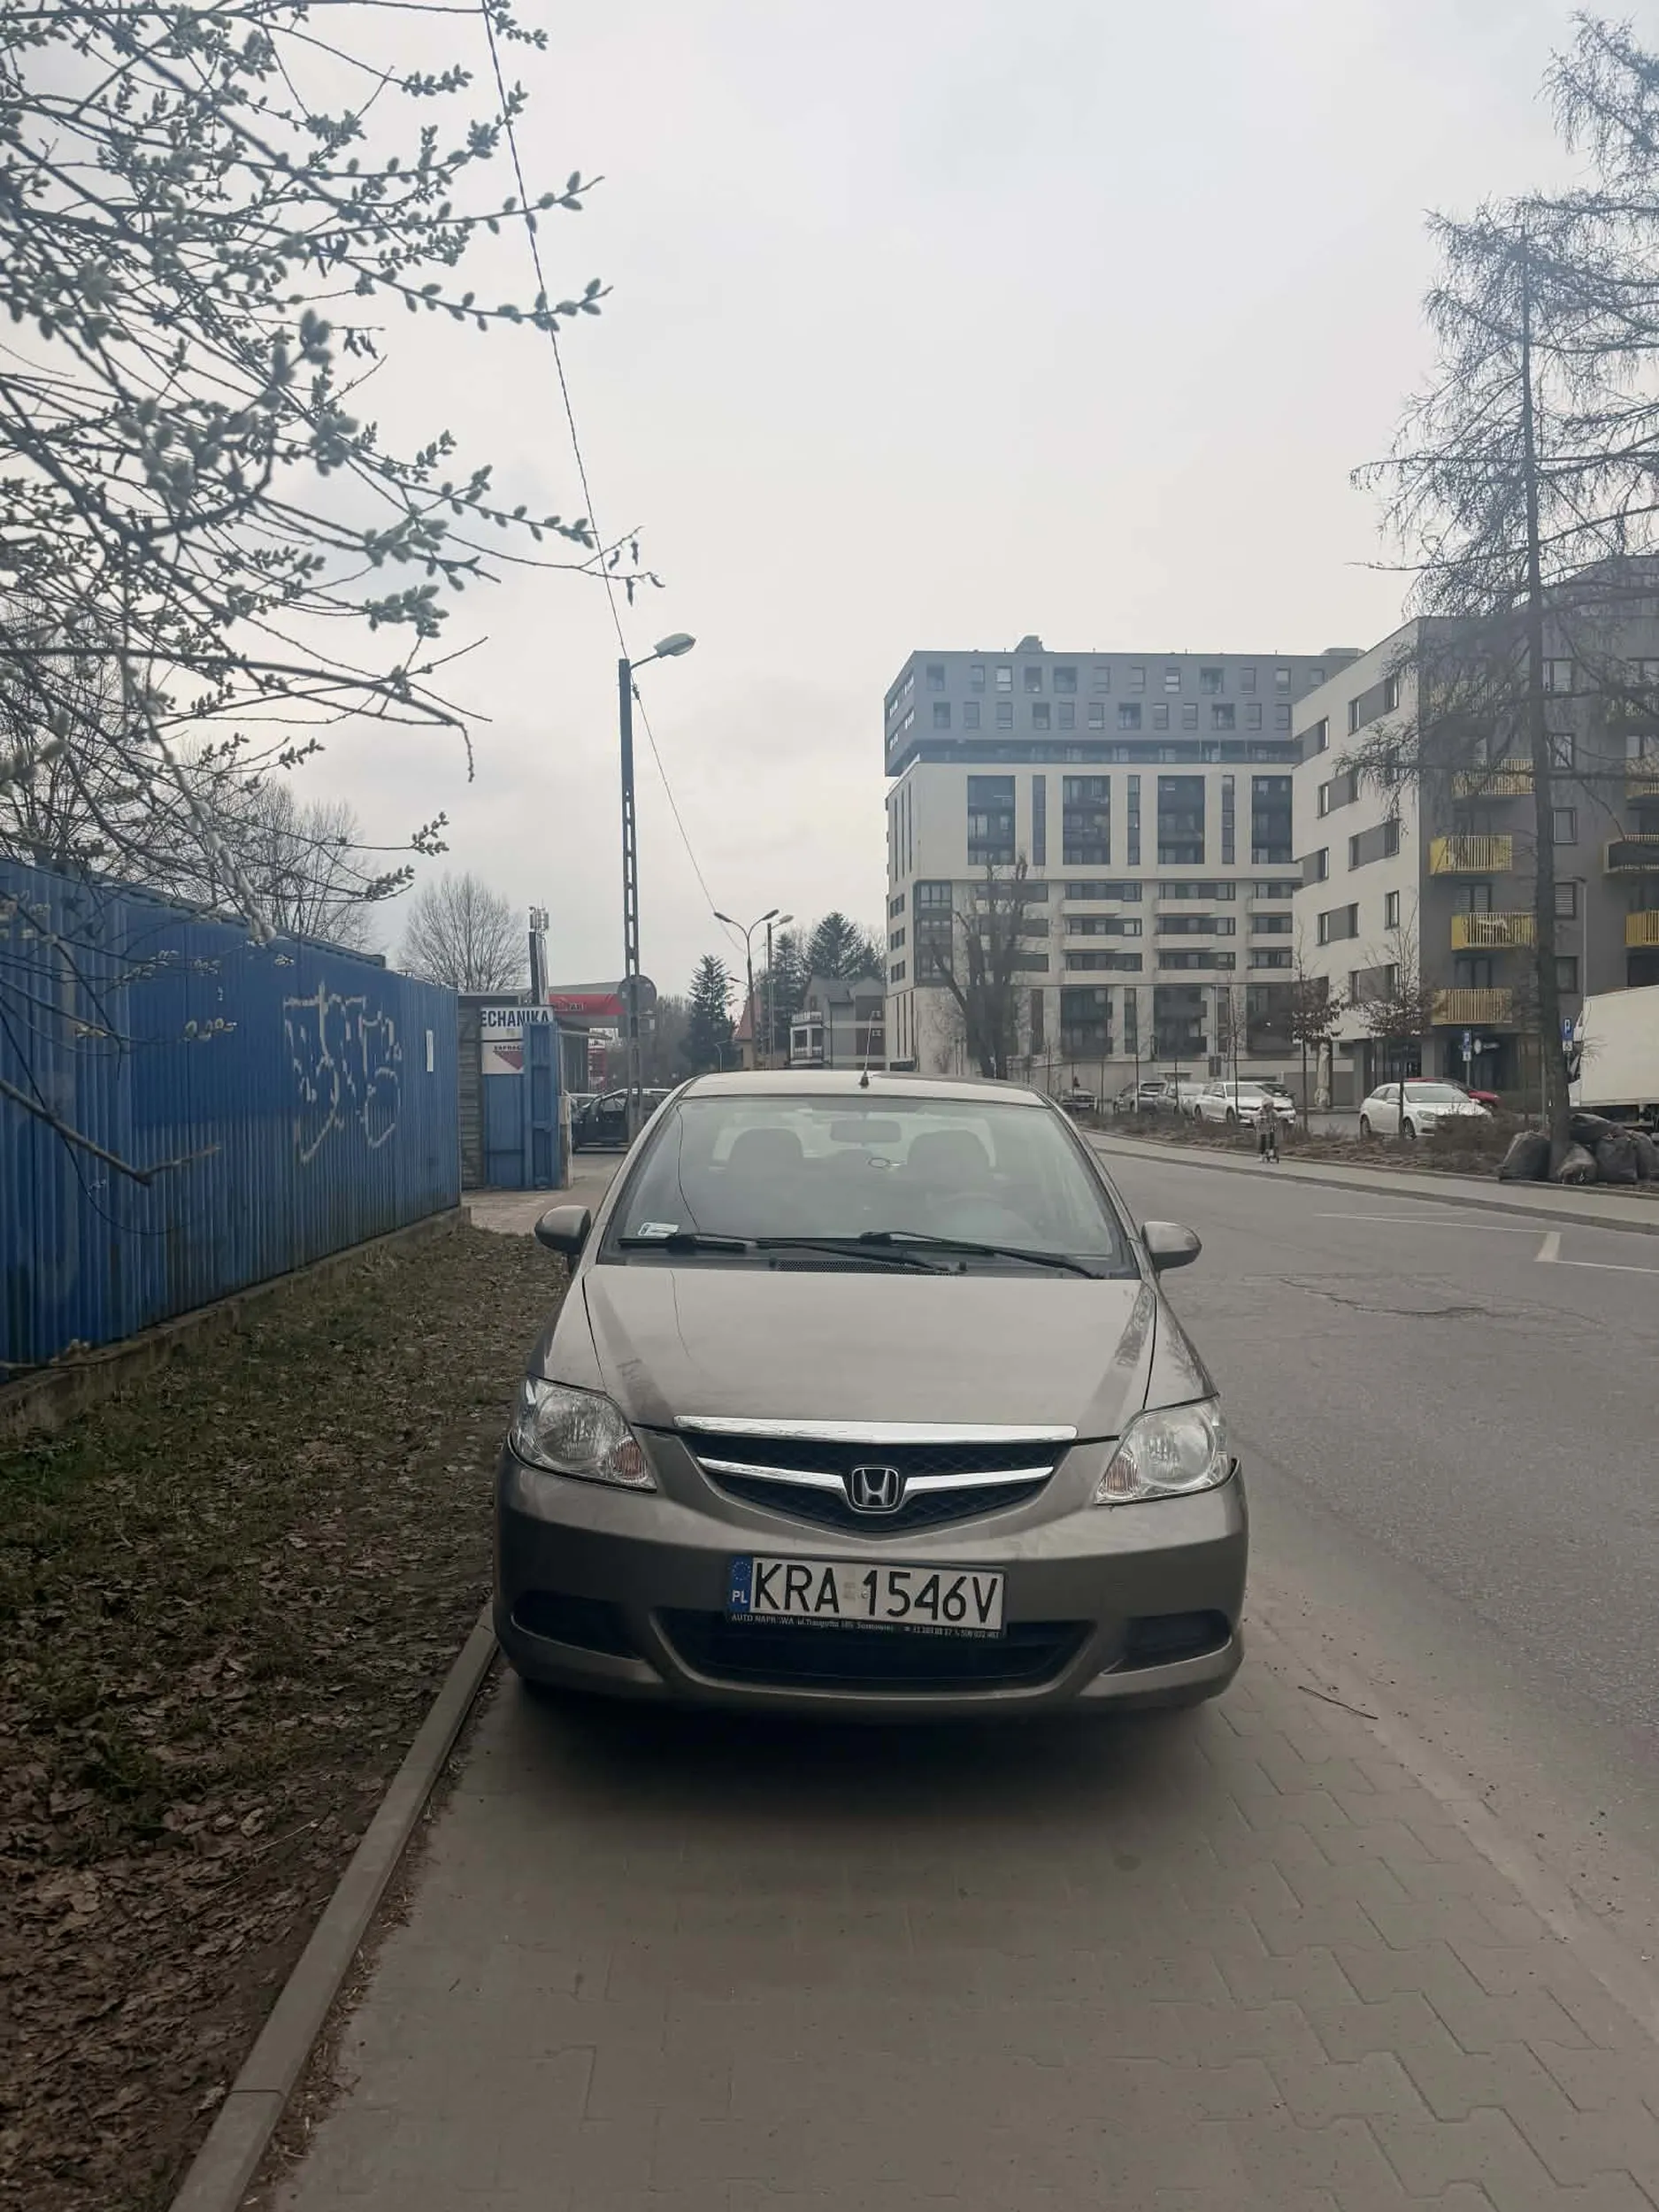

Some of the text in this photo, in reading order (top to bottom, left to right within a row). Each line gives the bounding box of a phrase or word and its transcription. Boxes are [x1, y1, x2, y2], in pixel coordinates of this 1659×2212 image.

[732, 1590, 749, 1604] PL
[755, 1563, 998, 1624] KRA 1546V
